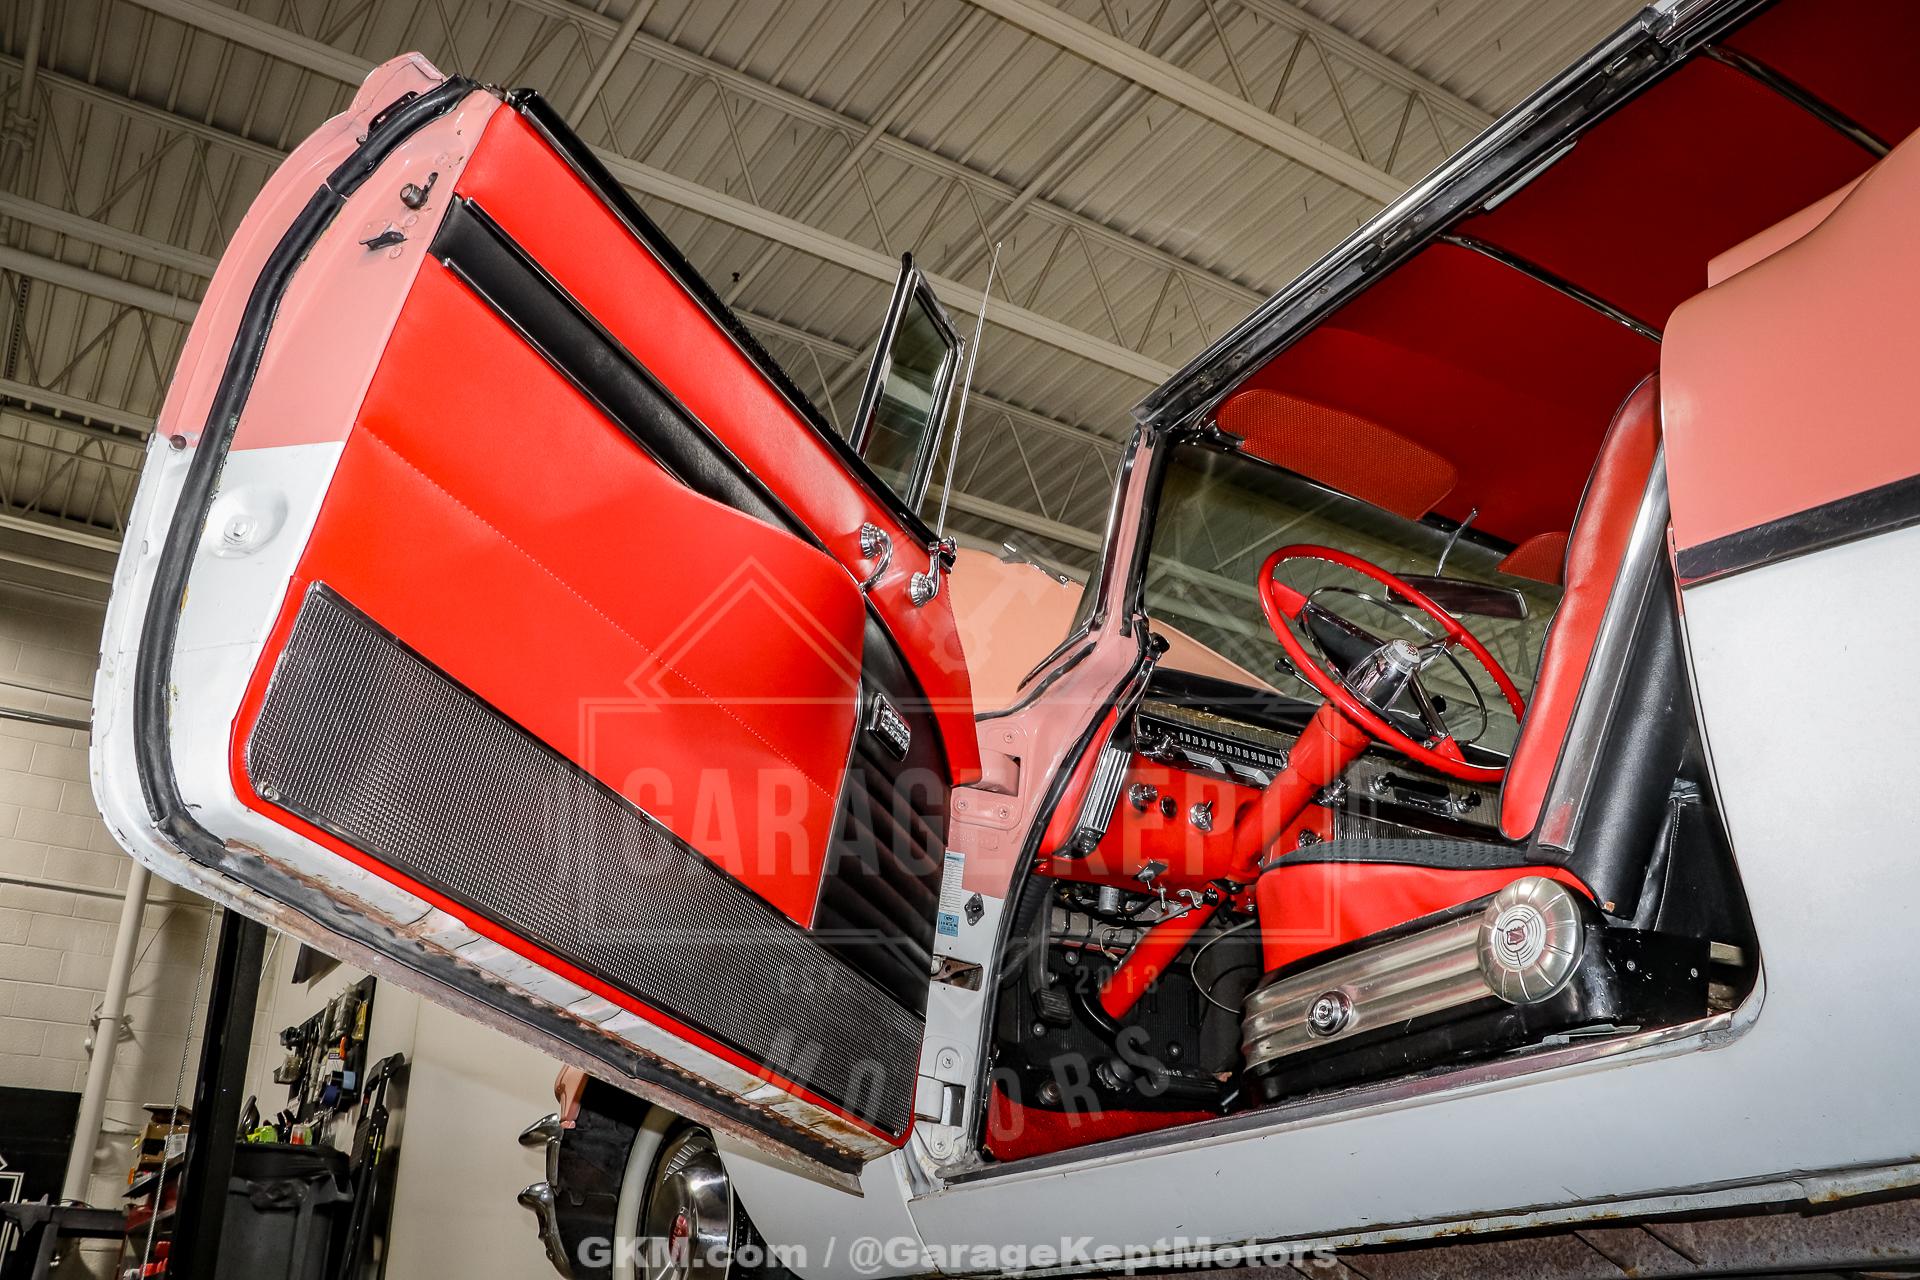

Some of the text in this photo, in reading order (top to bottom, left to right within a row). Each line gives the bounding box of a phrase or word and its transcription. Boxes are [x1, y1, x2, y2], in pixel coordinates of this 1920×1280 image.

[1200, 737, 1207, 747] 30
[1209, 740, 1216, 750] 40
[1217, 742, 1225, 752] 50
[1250, 751, 1258, 761] 90
